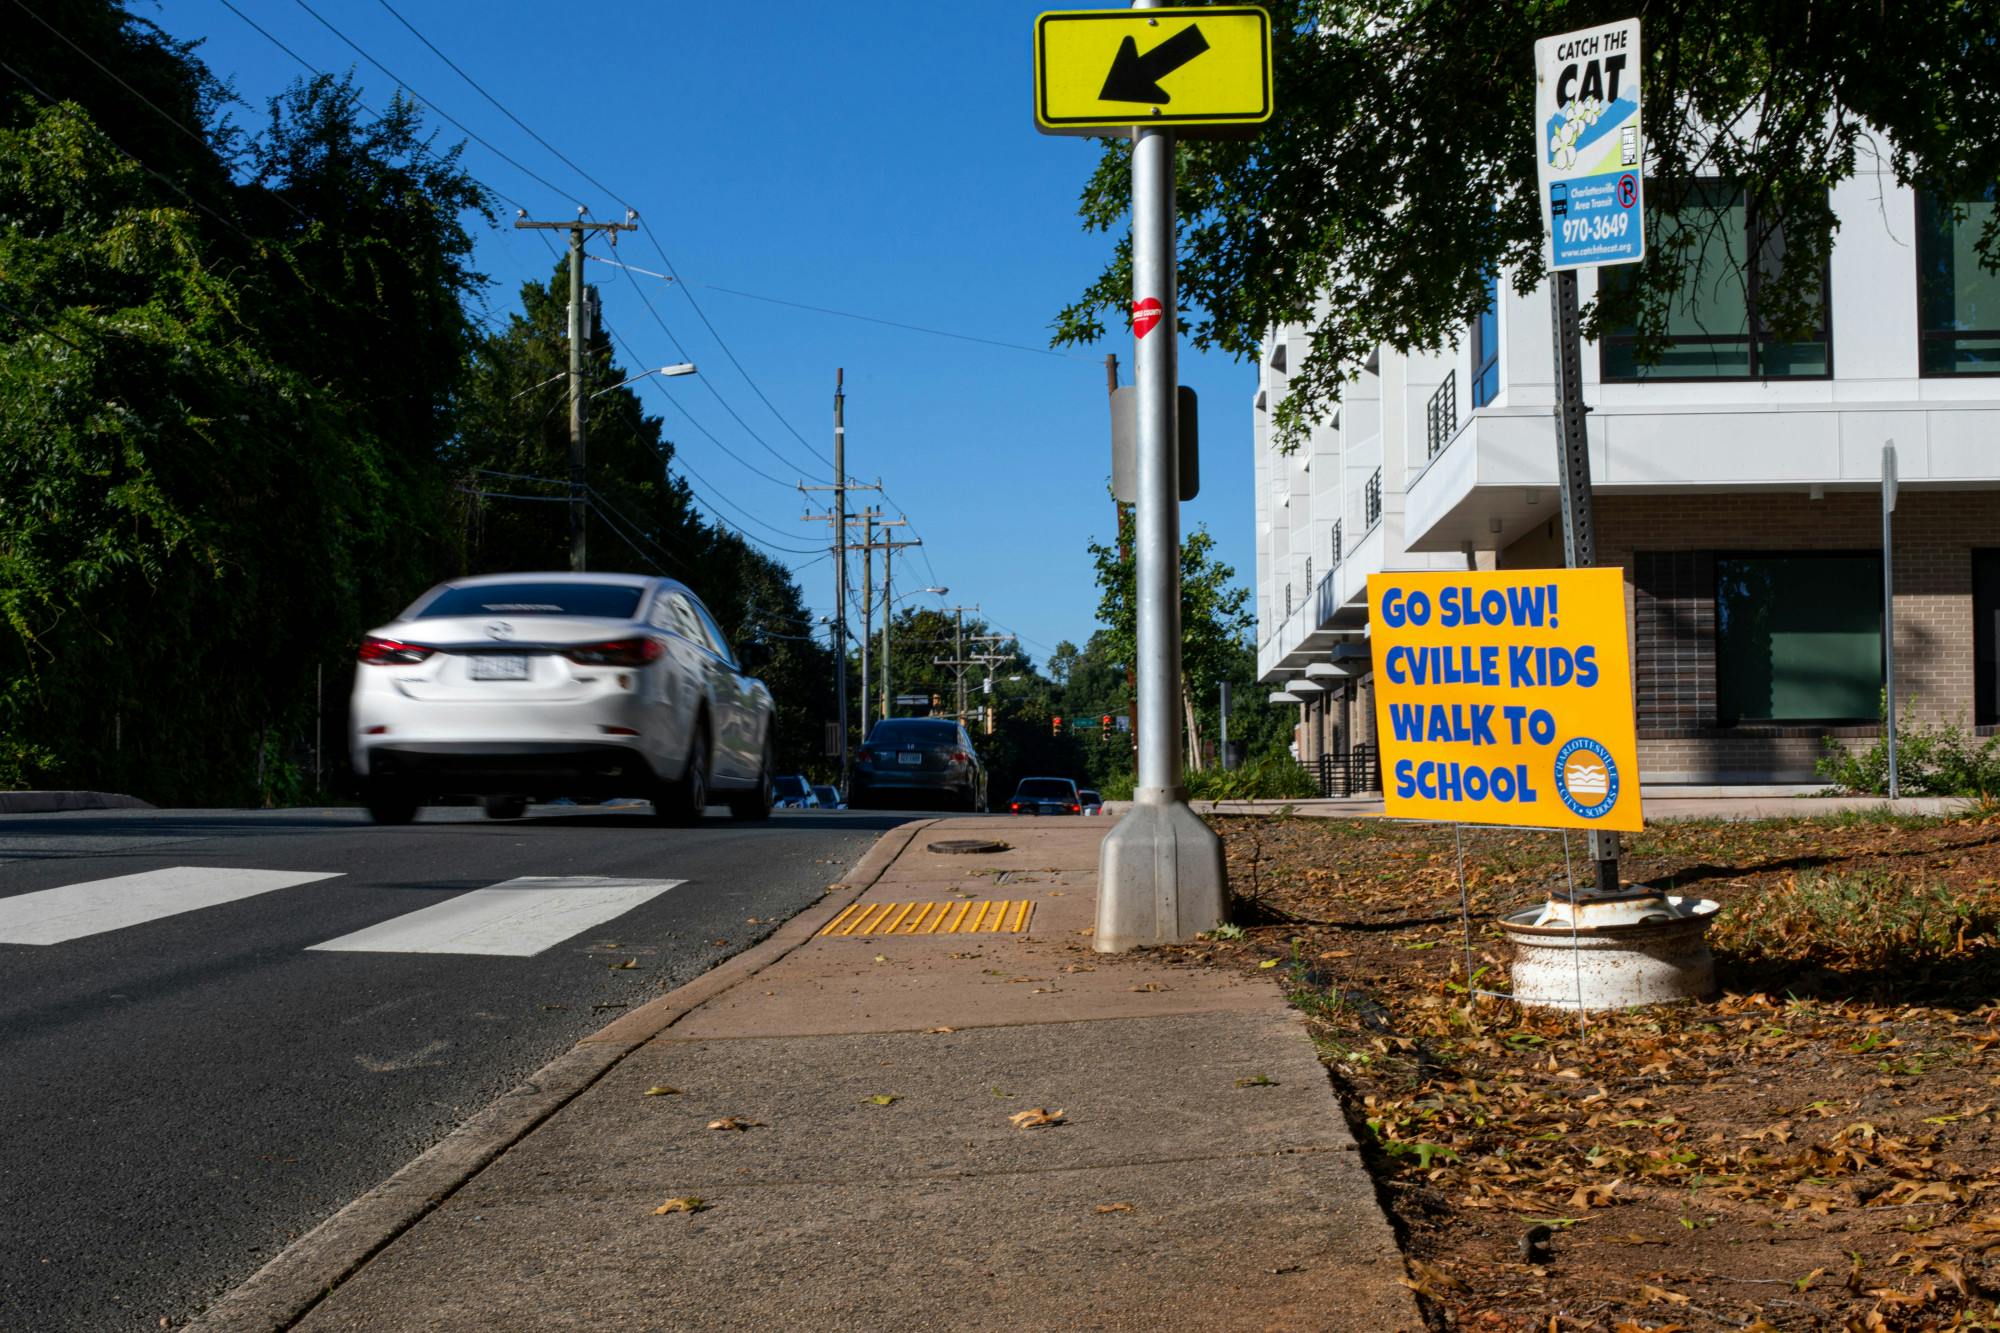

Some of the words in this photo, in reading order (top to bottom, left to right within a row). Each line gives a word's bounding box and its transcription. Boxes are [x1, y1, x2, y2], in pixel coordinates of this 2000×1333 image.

[1557, 36, 1600, 61] CATCH
[1603, 29, 1628, 51] THE
[1556, 53, 1627, 110] CAT
[1570, 183, 1615, 198] Charlottesville
[1574, 201, 1591, 211] Area
[1591, 197, 1613, 208] Transit
[1562, 213, 1628, 243] 970-3649
[1560, 243, 1632, 258] www.catchthecat.org
[1381, 587, 1431, 628] GO
[1439, 584, 1559, 629] SLOW!
[1385, 645, 1500, 686] CVILLE
[1508, 645, 1599, 688] KIDS
[1389, 703, 1497, 746] WALK
[1503, 705, 1556, 746] TO
[1394, 759, 1537, 803] SCHOOL
[1559, 789, 1580, 810] CITY
[1585, 791, 1617, 817] SCHOOLS
